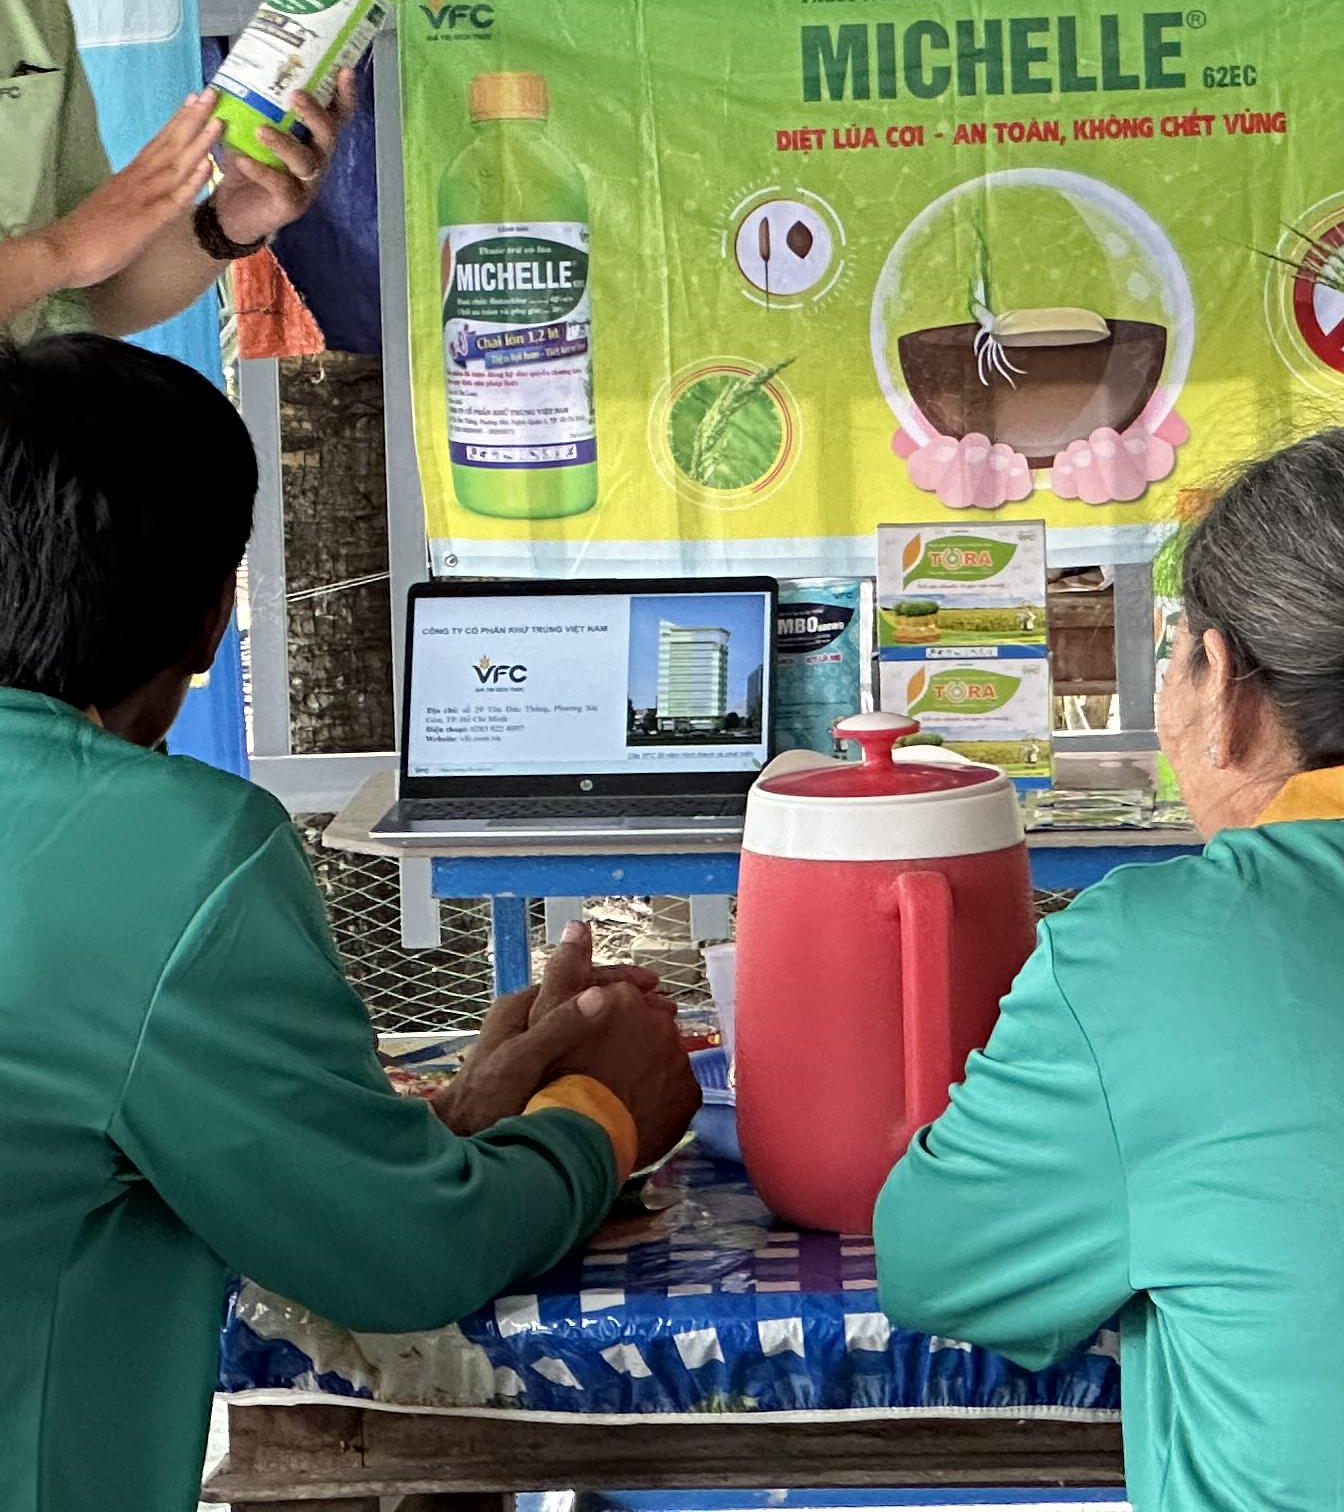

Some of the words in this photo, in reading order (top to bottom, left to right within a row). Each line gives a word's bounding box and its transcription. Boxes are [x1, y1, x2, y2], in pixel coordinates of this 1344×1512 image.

[418, 3, 495, 29] VFC
[1202, 64, 1257, 89] 62EC
[776, 127, 824, 155] DIỆT
[833, 122, 879, 149] LÚA
[955, 121, 993, 145] AN
[998, 115, 1066, 146] TOÀN,
[1073, 113, 1154, 140] KHÔNG
[1160, 106, 1215, 137] CHẾT
[456, 260, 572, 292] MICHELLE
[528, 329, 547, 345] 1,2
[777, 616, 818, 635] MBO
[472, 665, 528, 684] VFC
